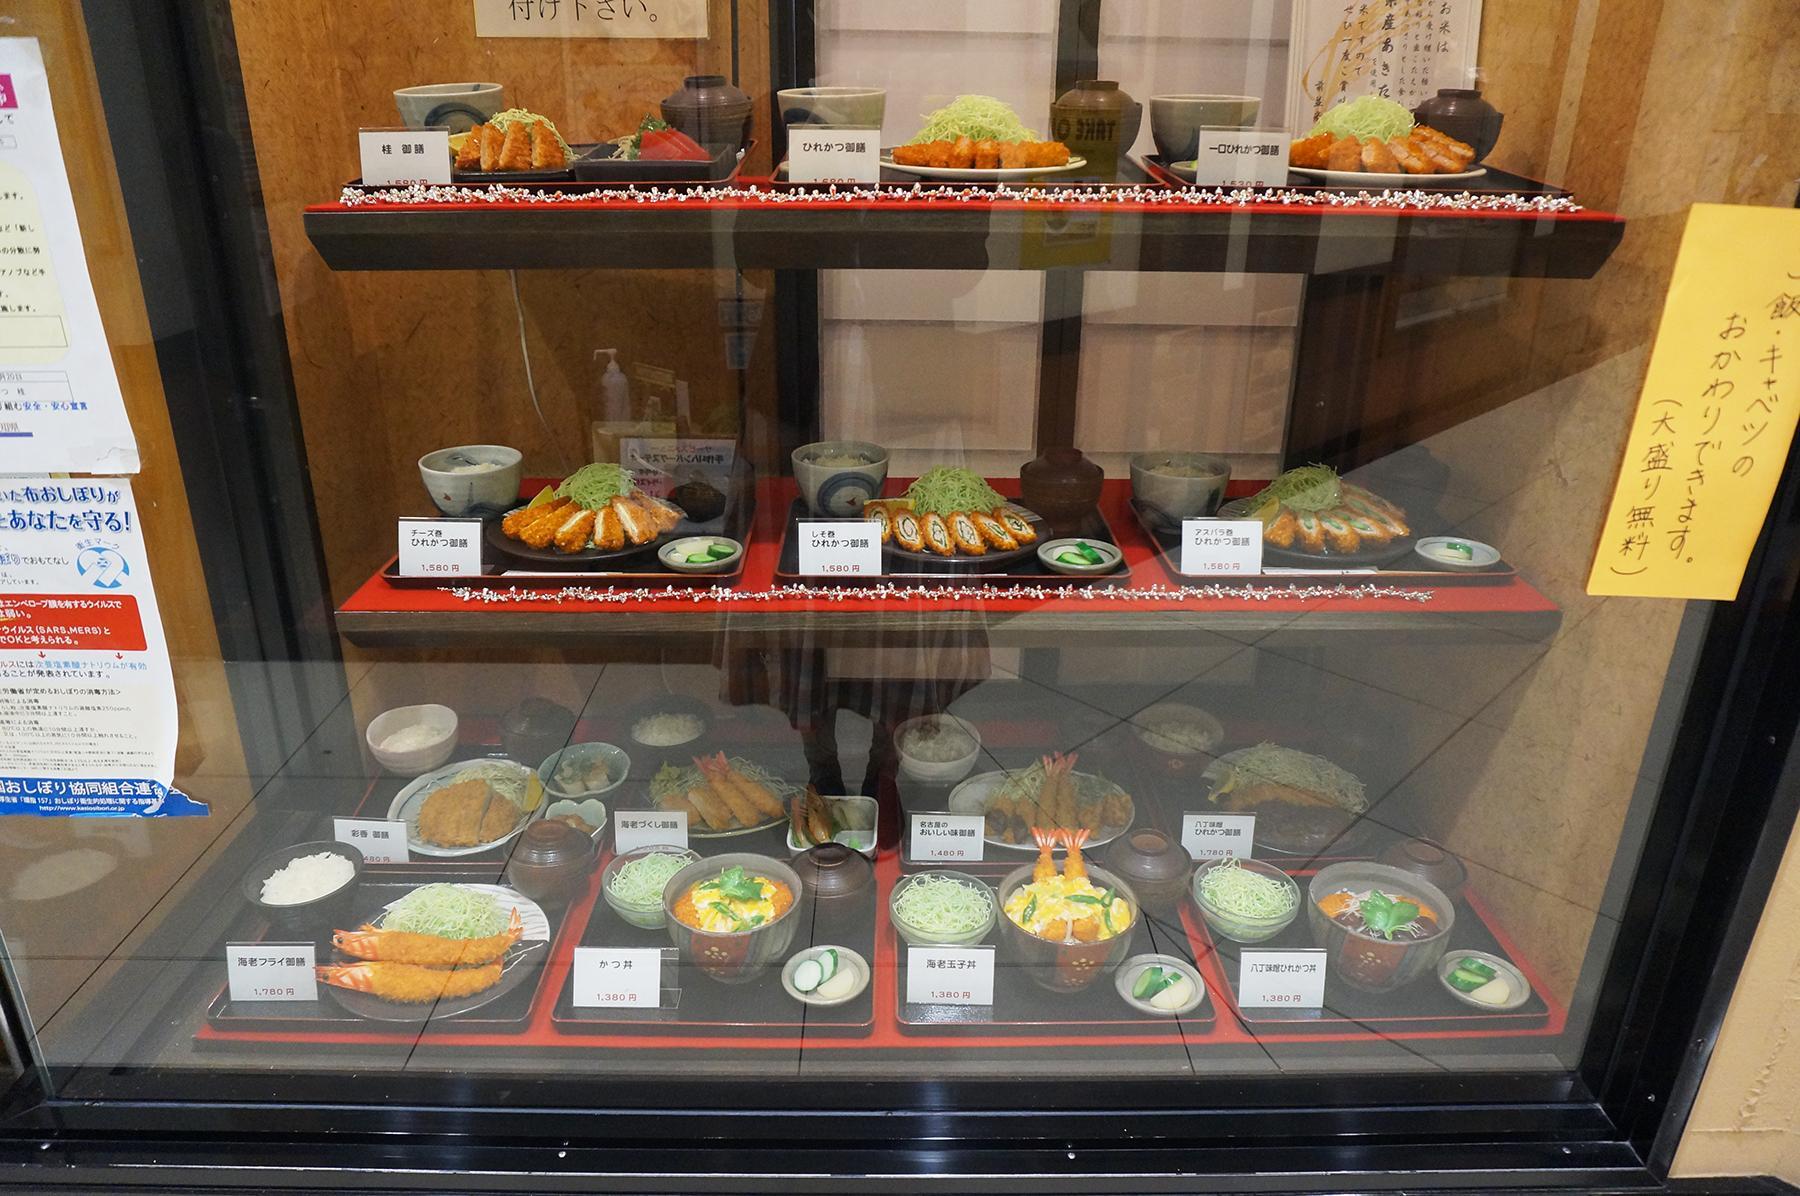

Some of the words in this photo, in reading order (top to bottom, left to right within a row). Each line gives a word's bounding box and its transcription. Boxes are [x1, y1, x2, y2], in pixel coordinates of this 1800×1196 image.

[382, 144, 392, 155] 桂
[802, 142, 866, 153] ひれかつ御膳
[1209, 144, 1280, 156] 一口ひれかつ御膳
[1666, 312, 1747, 564] おかわりできます。
[411, 528, 443, 538] チーズ巻
[811, 530, 835, 538] しそ巻
[1195, 528, 1233, 537] アスパラ巻
[411, 538, 468, 548] ひれかつ御膳
[811, 538, 869, 548] ひれかつ御膳
[1194, 537, 1250, 546] ひれかつ御膳
[621, 820, 678, 829] 海老づくし御膳
[920, 821, 948, 829] 名古屋の
[919, 828, 976, 837] おいしい味御膳
[1194, 828, 1241, 837] ひれかつ御膳
[237, 957, 306, 967] 海老フライ御膳
[599, 960, 633, 970] かつ丼
[926, 959, 977, 970] 海老玉子丼
